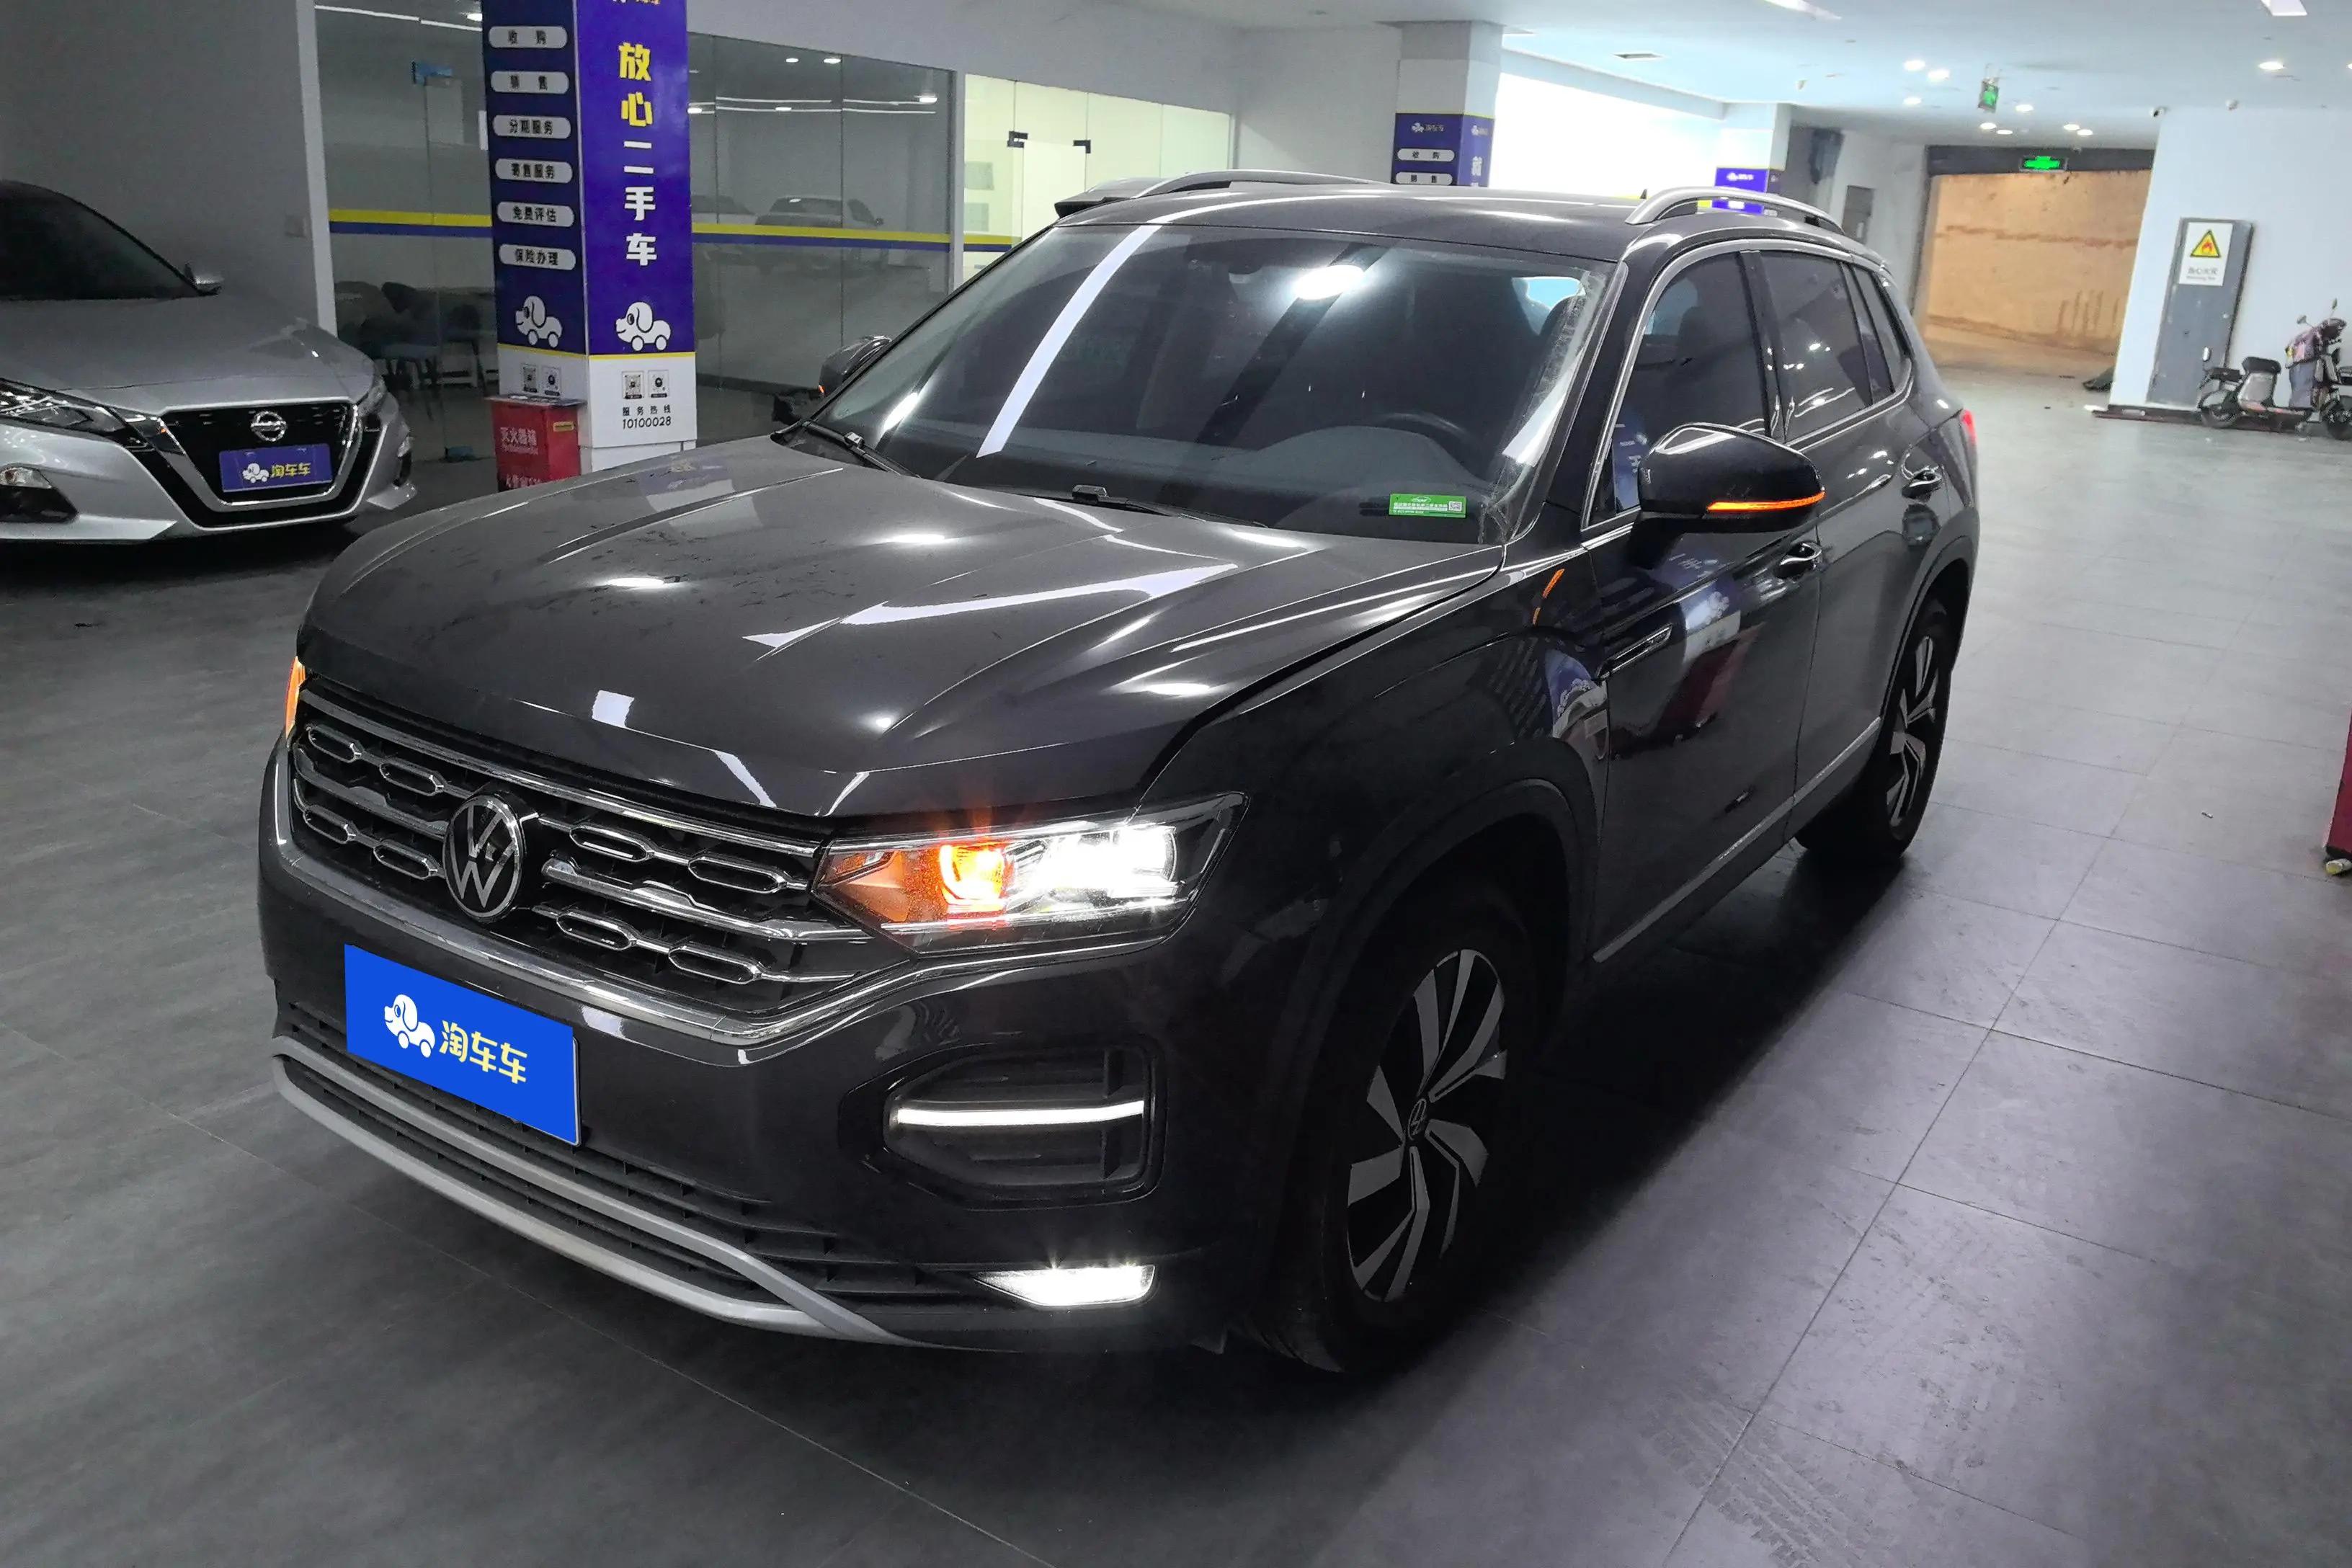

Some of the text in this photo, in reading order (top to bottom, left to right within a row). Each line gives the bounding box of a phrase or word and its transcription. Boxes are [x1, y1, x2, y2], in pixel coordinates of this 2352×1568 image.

[618, 42, 657, 267] 放心二手车
[515, 249, 558, 266] 保险办理
[623, 404, 671, 416] 服务热线
[623, 416, 672, 429] 10100028
[270, 462, 311, 478] 淘车车
